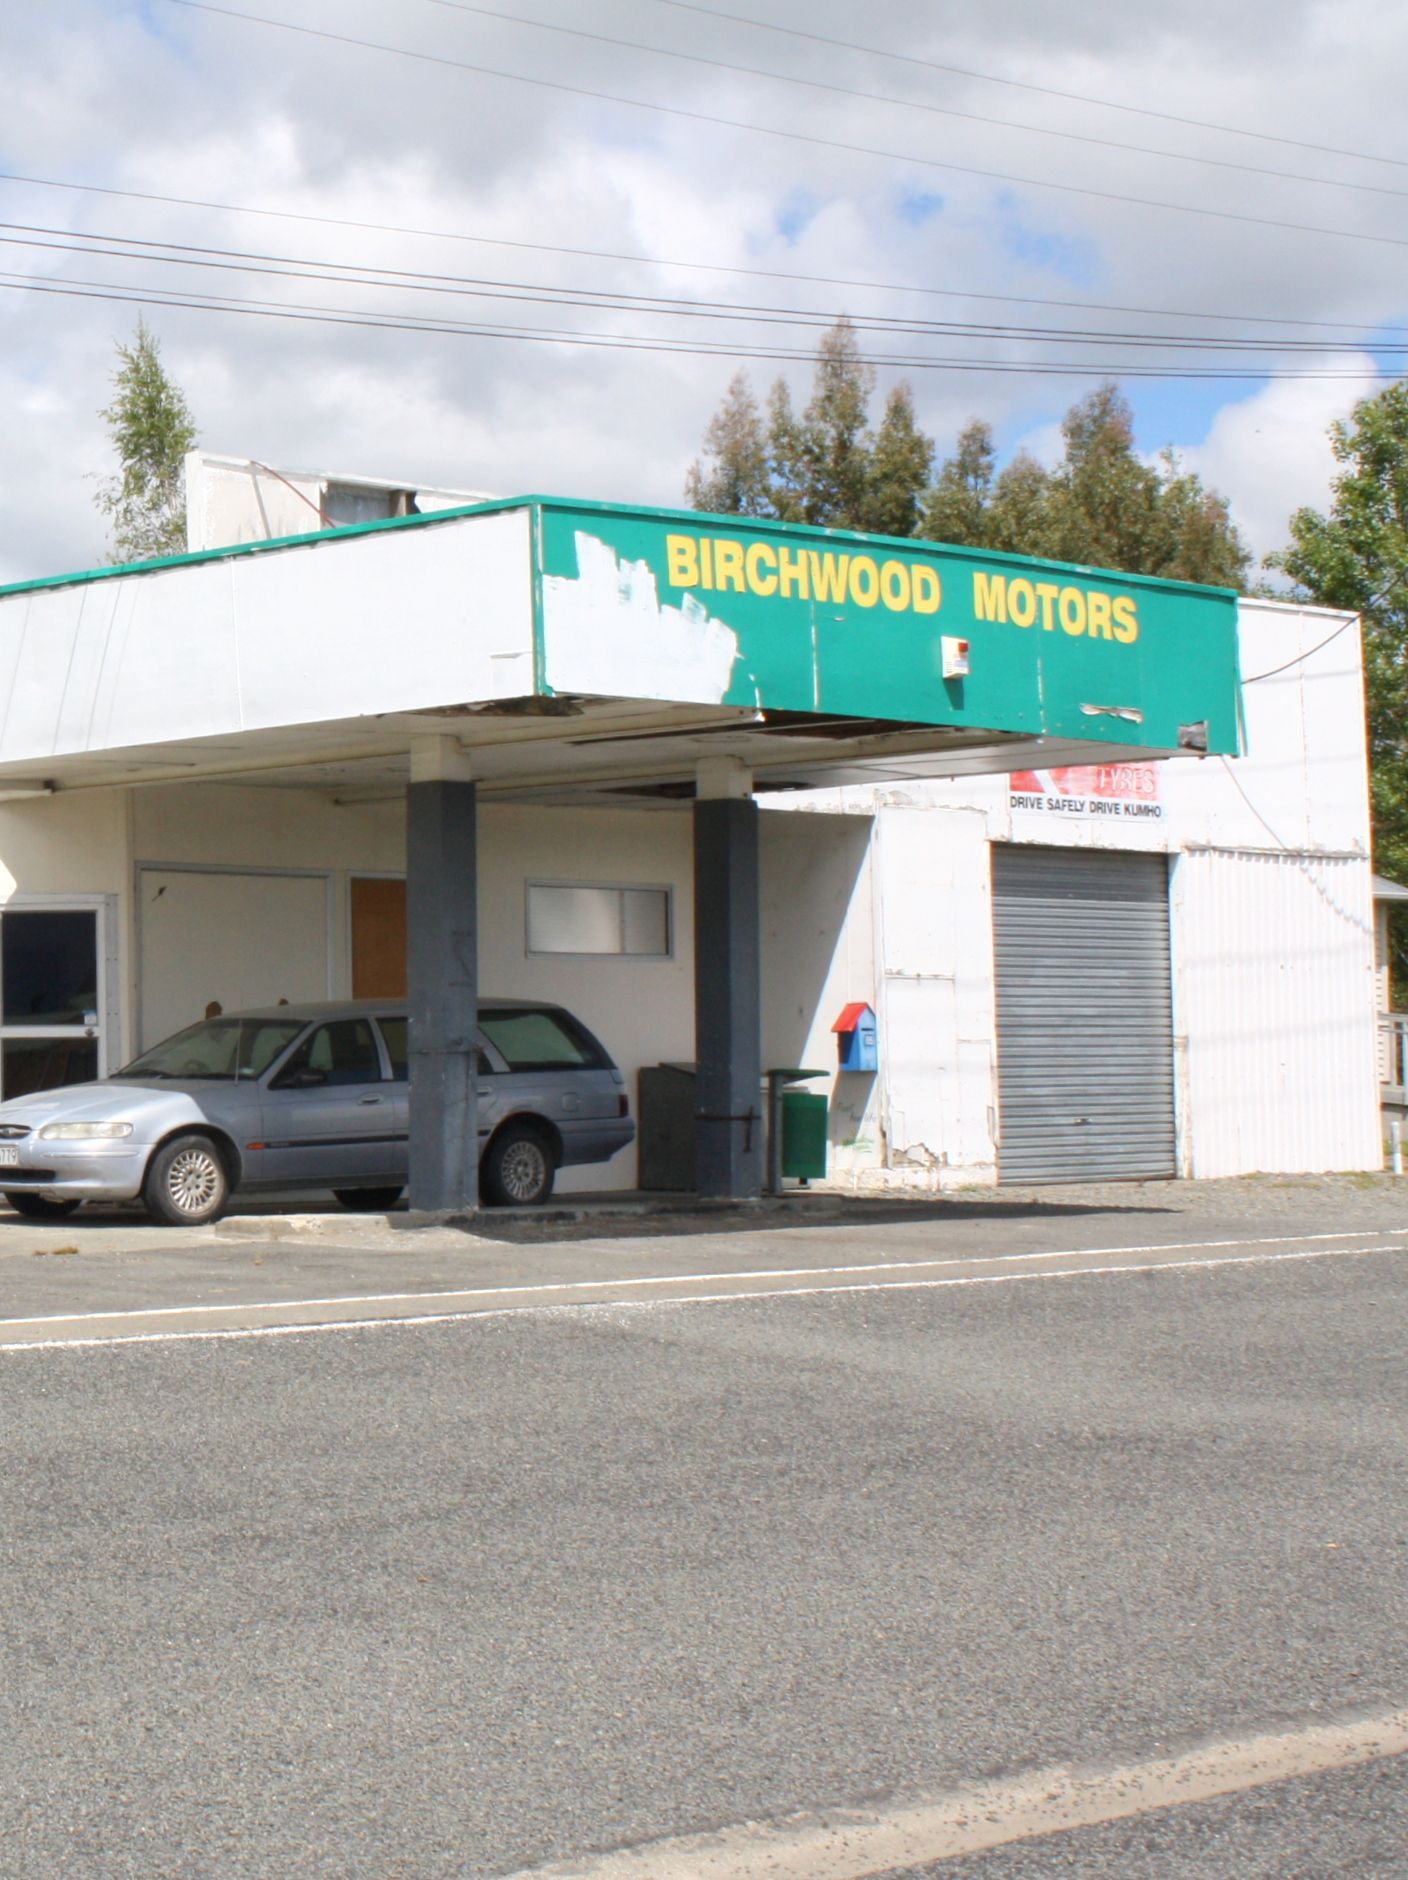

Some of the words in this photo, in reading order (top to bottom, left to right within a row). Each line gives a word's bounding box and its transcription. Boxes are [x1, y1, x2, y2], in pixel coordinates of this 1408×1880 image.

[665, 534, 941, 614] BIRCHWOOD
[972, 571, 1139, 645] MOTORS
[1097, 766, 1155, 794] TYRES
[1010, 796, 1043, 810] DRIVE
[1047, 797, 1085, 812] SAFELY
[1089, 800, 1120, 815] DRIVE
[1124, 803, 1162, 818] KUMHO
